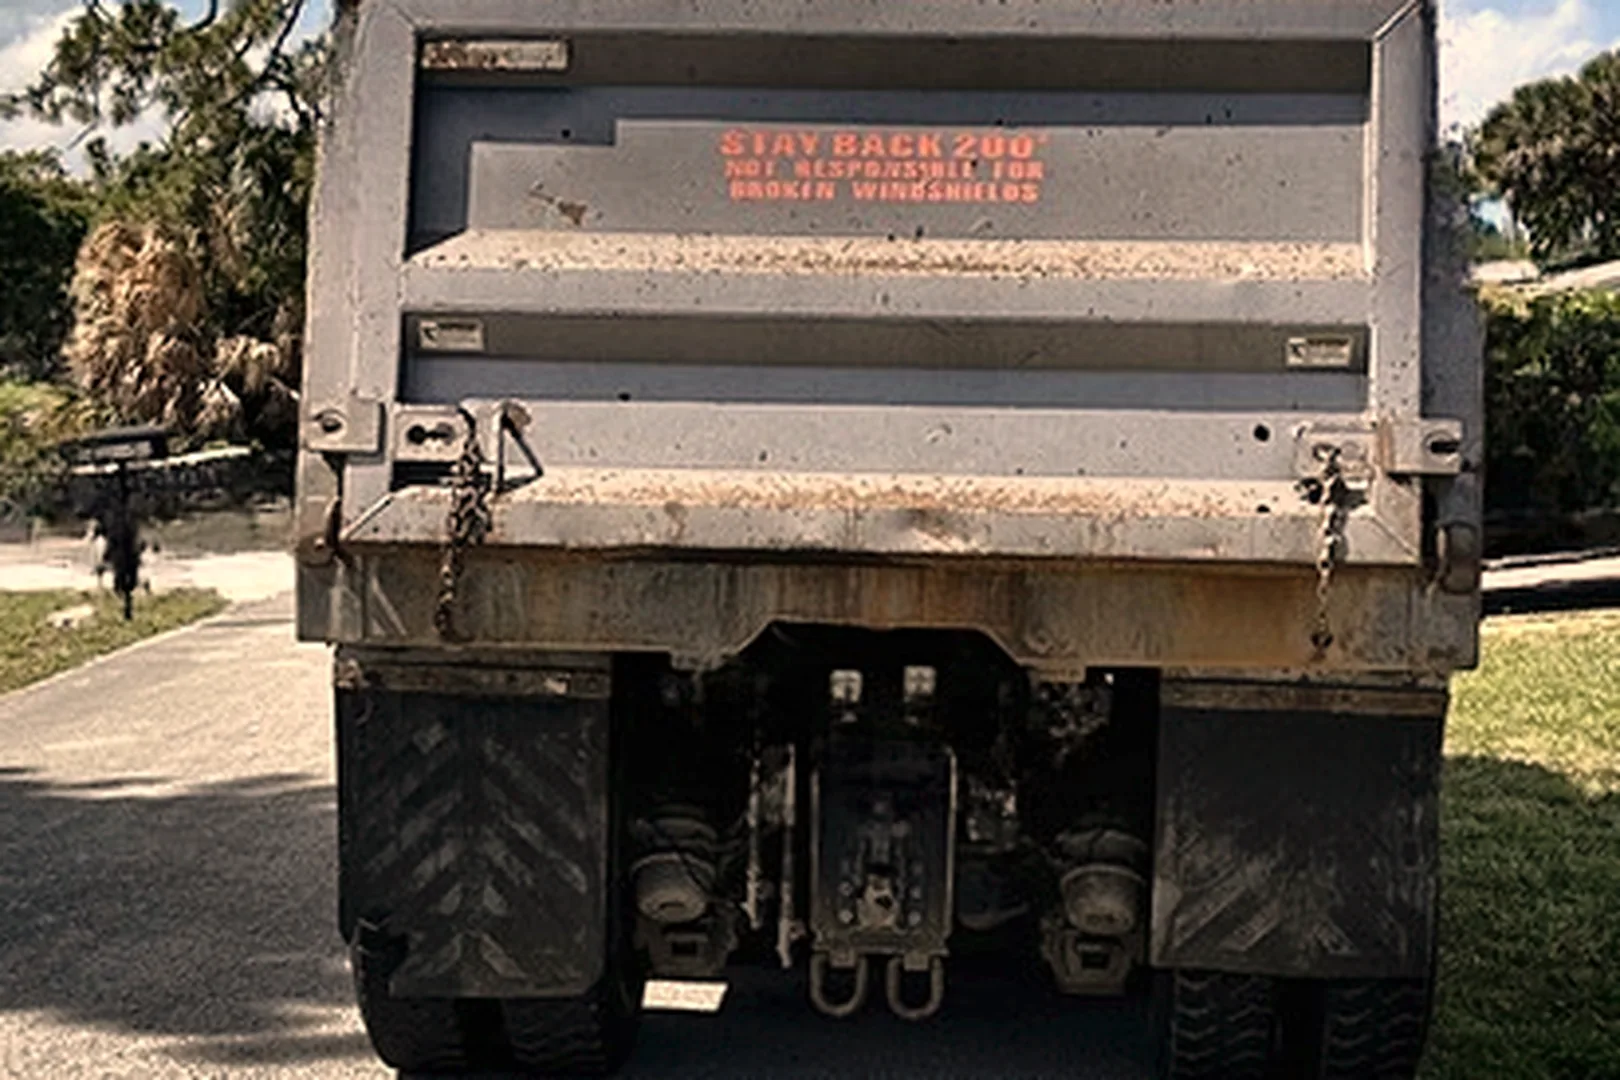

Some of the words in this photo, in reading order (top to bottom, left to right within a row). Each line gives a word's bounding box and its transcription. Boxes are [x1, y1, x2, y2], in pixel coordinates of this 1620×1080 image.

[719, 129, 820, 157] STAY
[832, 131, 941, 159] BACK
[724, 160, 777, 178] NOT
[794, 160, 975, 180] RESPONSIBLE
[992, 161, 1044, 180] FOR
[729, 180, 835, 202] BROKEN
[851, 181, 1039, 203] WINDSHIELDS
